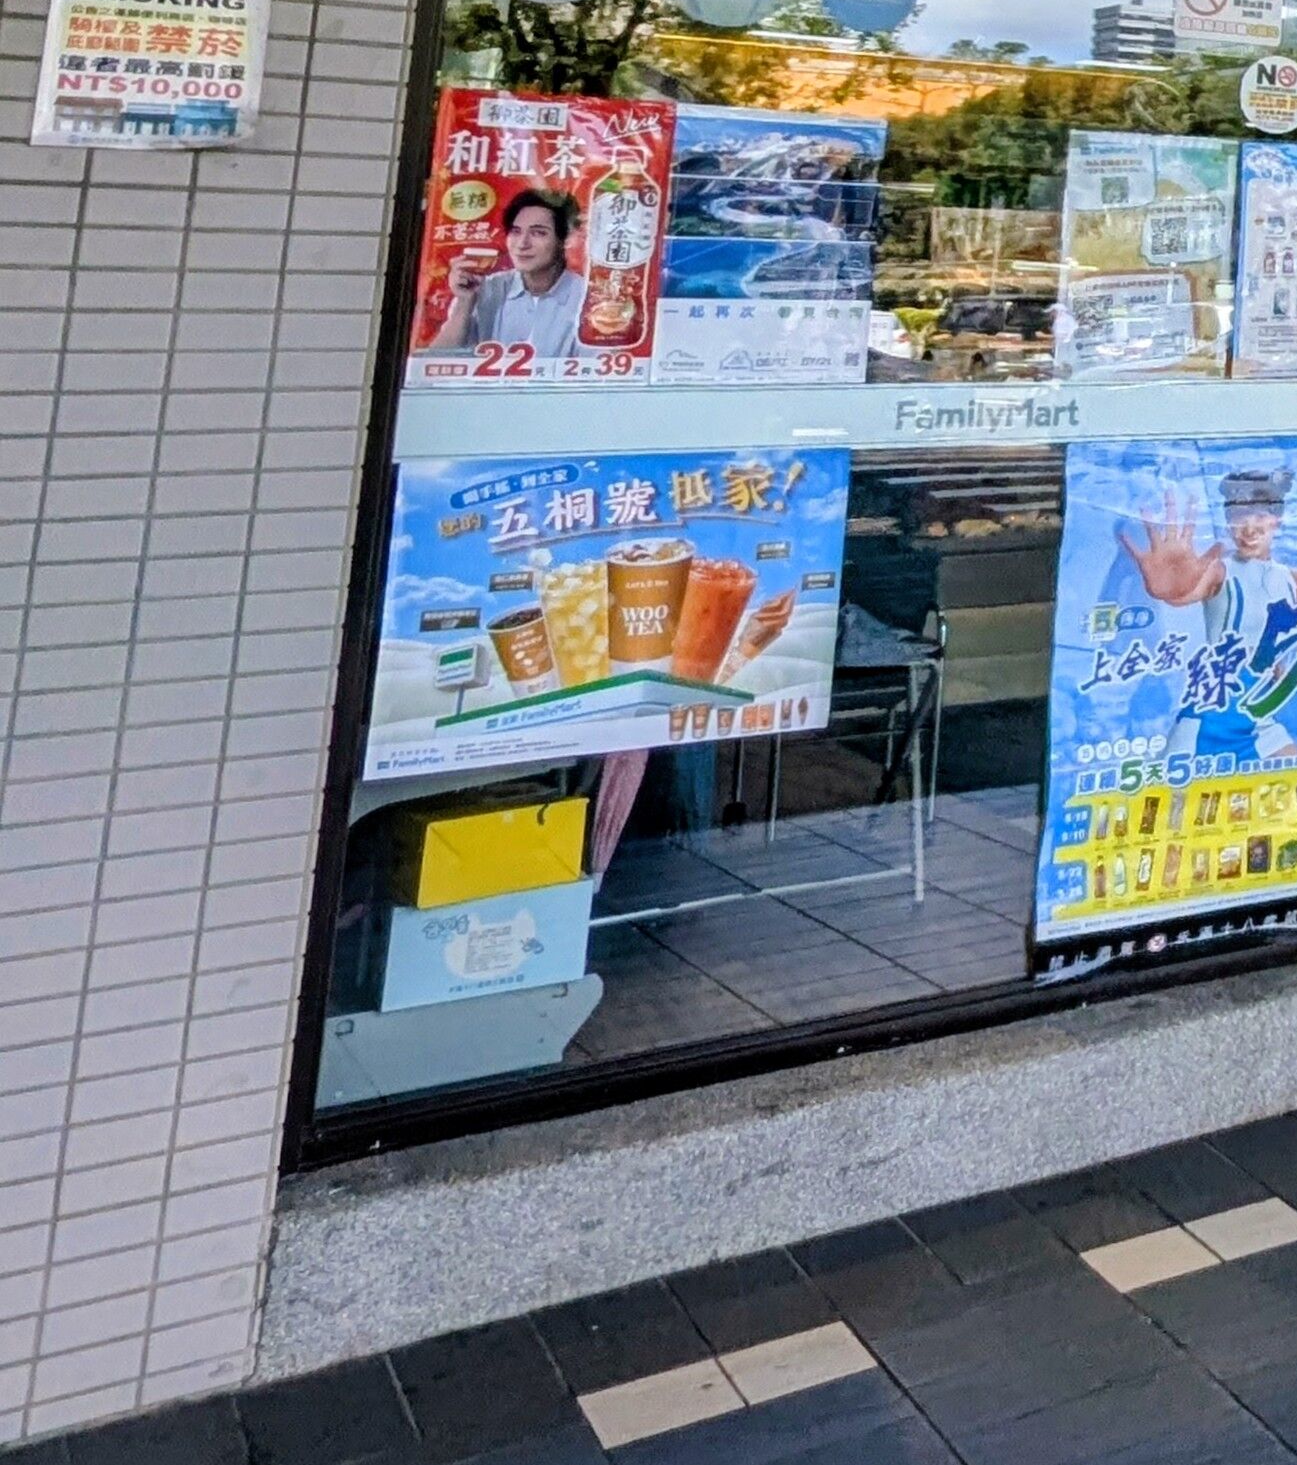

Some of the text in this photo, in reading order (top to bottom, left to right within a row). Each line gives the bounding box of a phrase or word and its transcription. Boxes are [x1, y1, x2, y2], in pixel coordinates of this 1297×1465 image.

[145, 23, 246, 57] 禁菸
[57, 73, 243, 99] NT$10,000
[445, 129, 587, 179] 和紅茶
[895, 398, 1080, 433] FamilyMart
[621, 604, 670, 623] WOO
[625, 620, 664, 636] TEA
